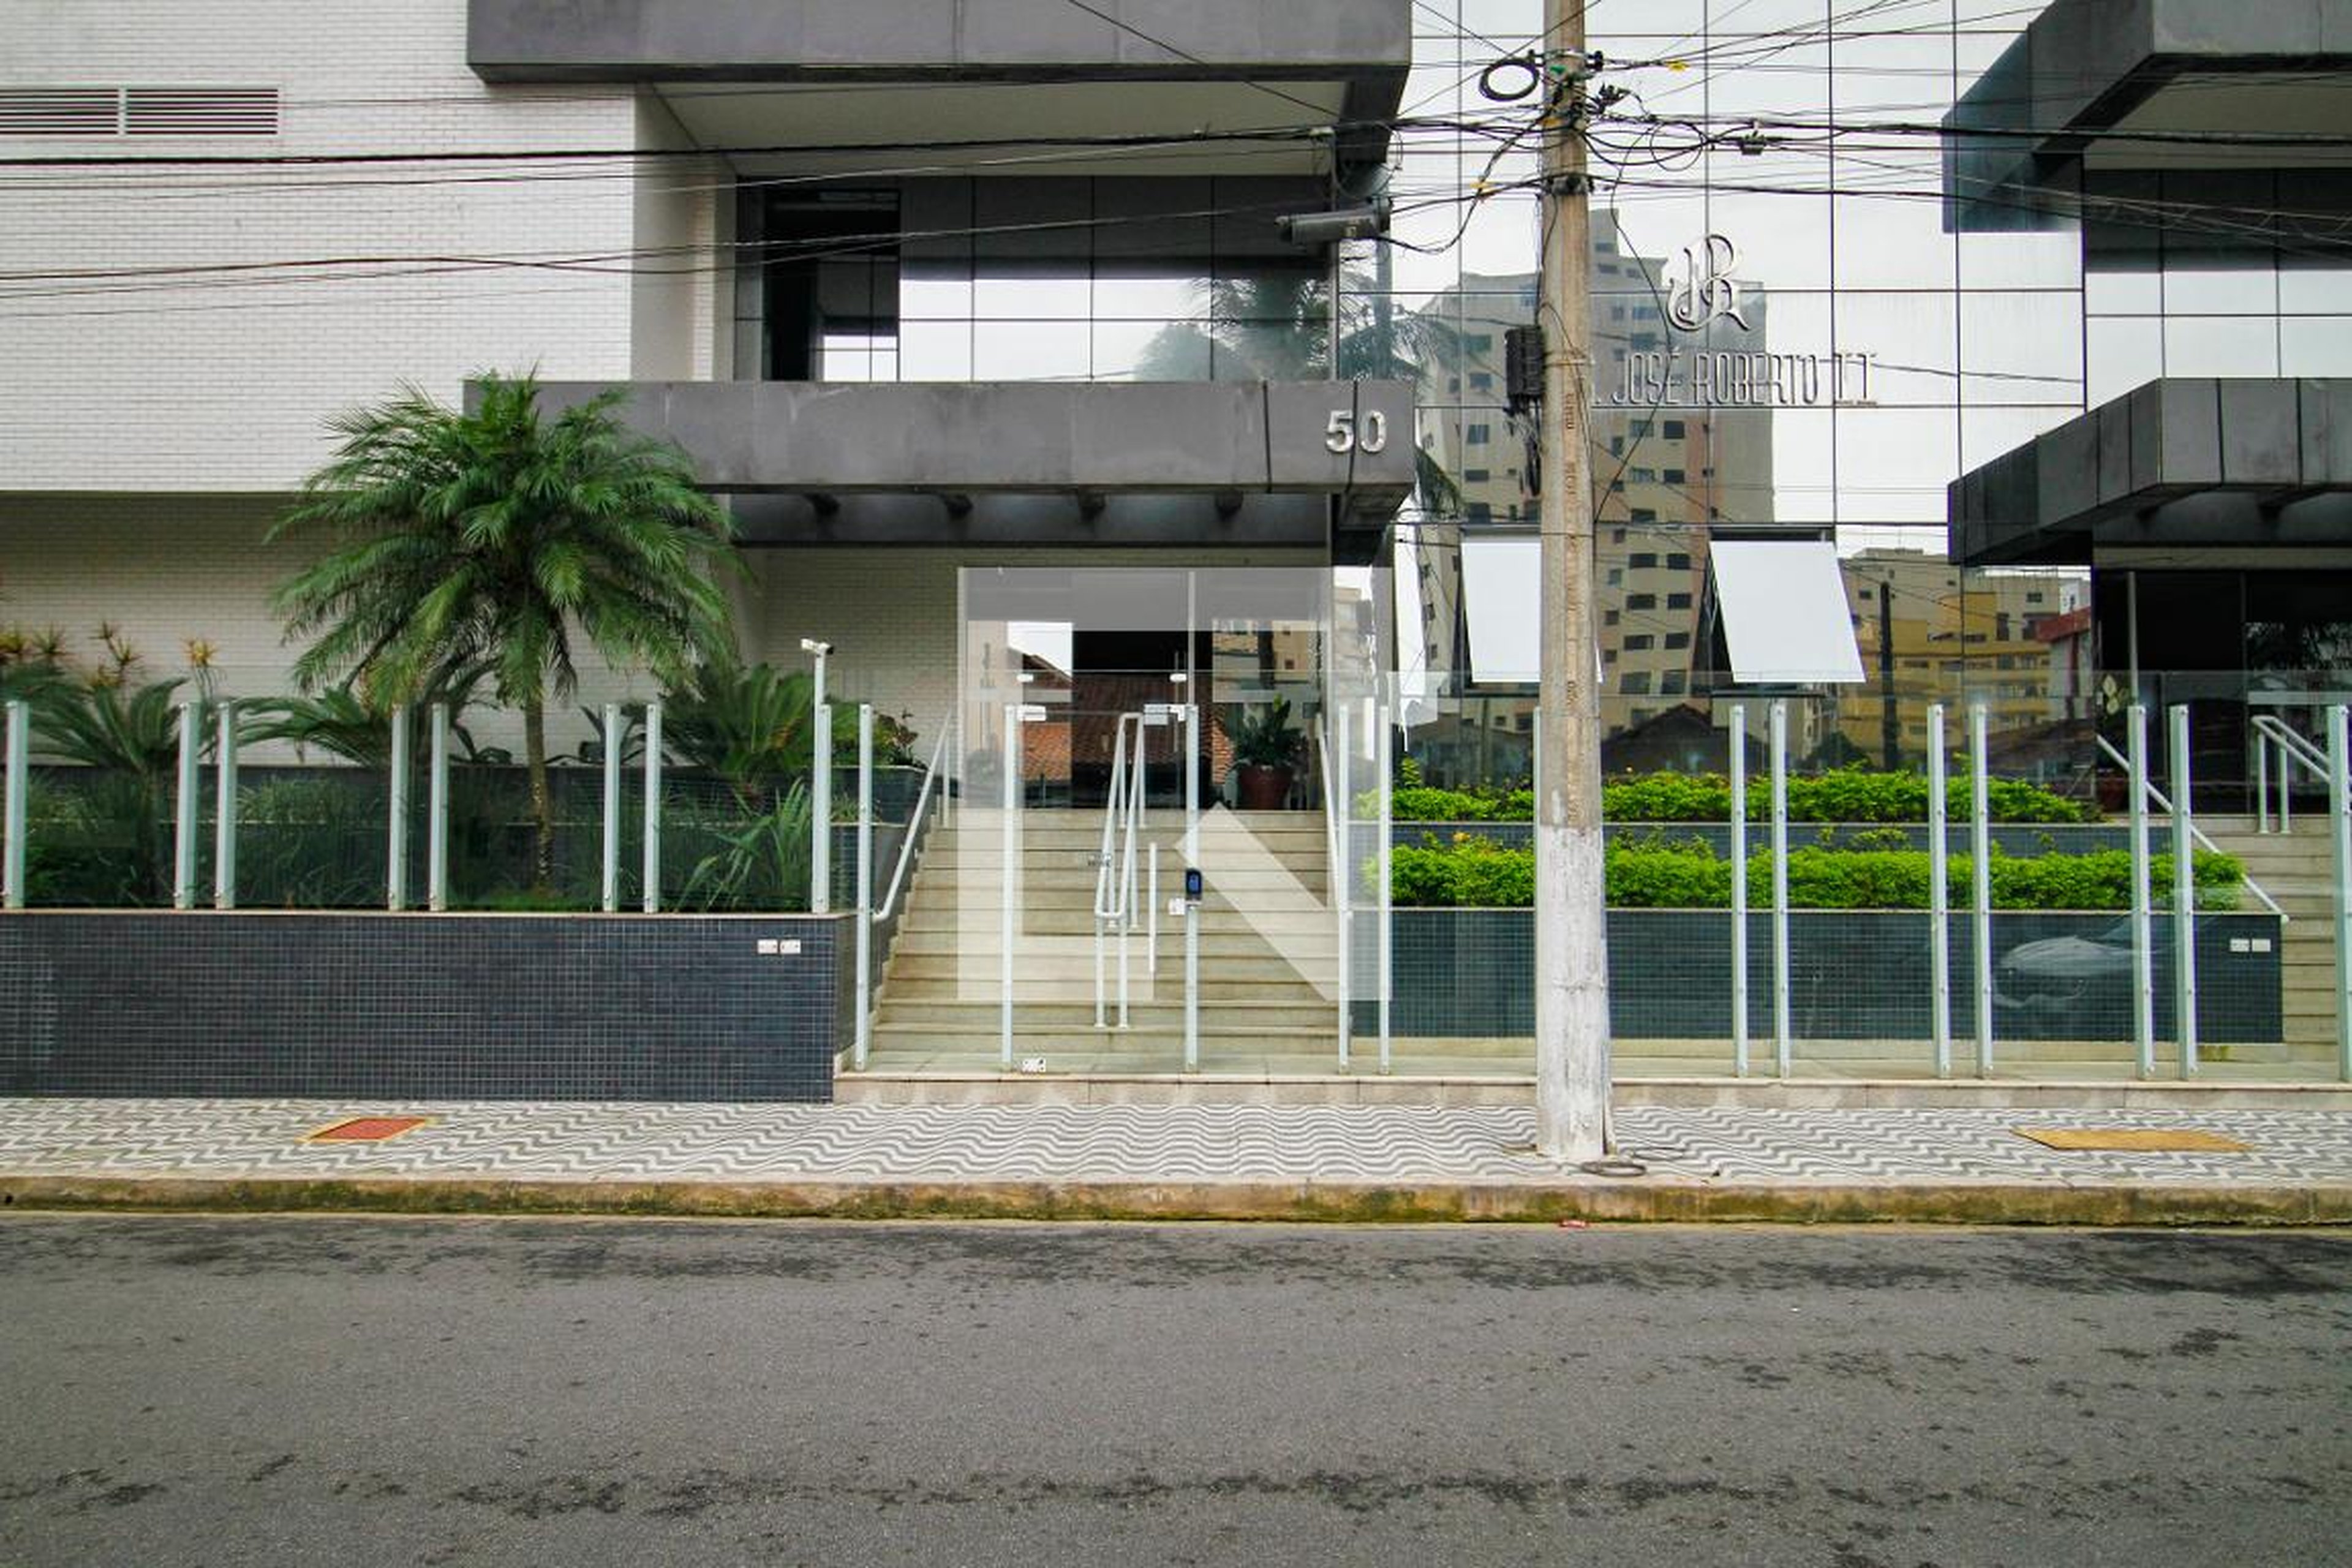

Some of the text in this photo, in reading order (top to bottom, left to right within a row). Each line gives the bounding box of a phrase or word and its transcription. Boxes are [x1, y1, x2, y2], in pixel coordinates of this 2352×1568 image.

[1611, 346, 1681, 404] JOSÉ
[1693, 352, 1819, 405] ROBERTO
[1325, 410, 1387, 453] 50
